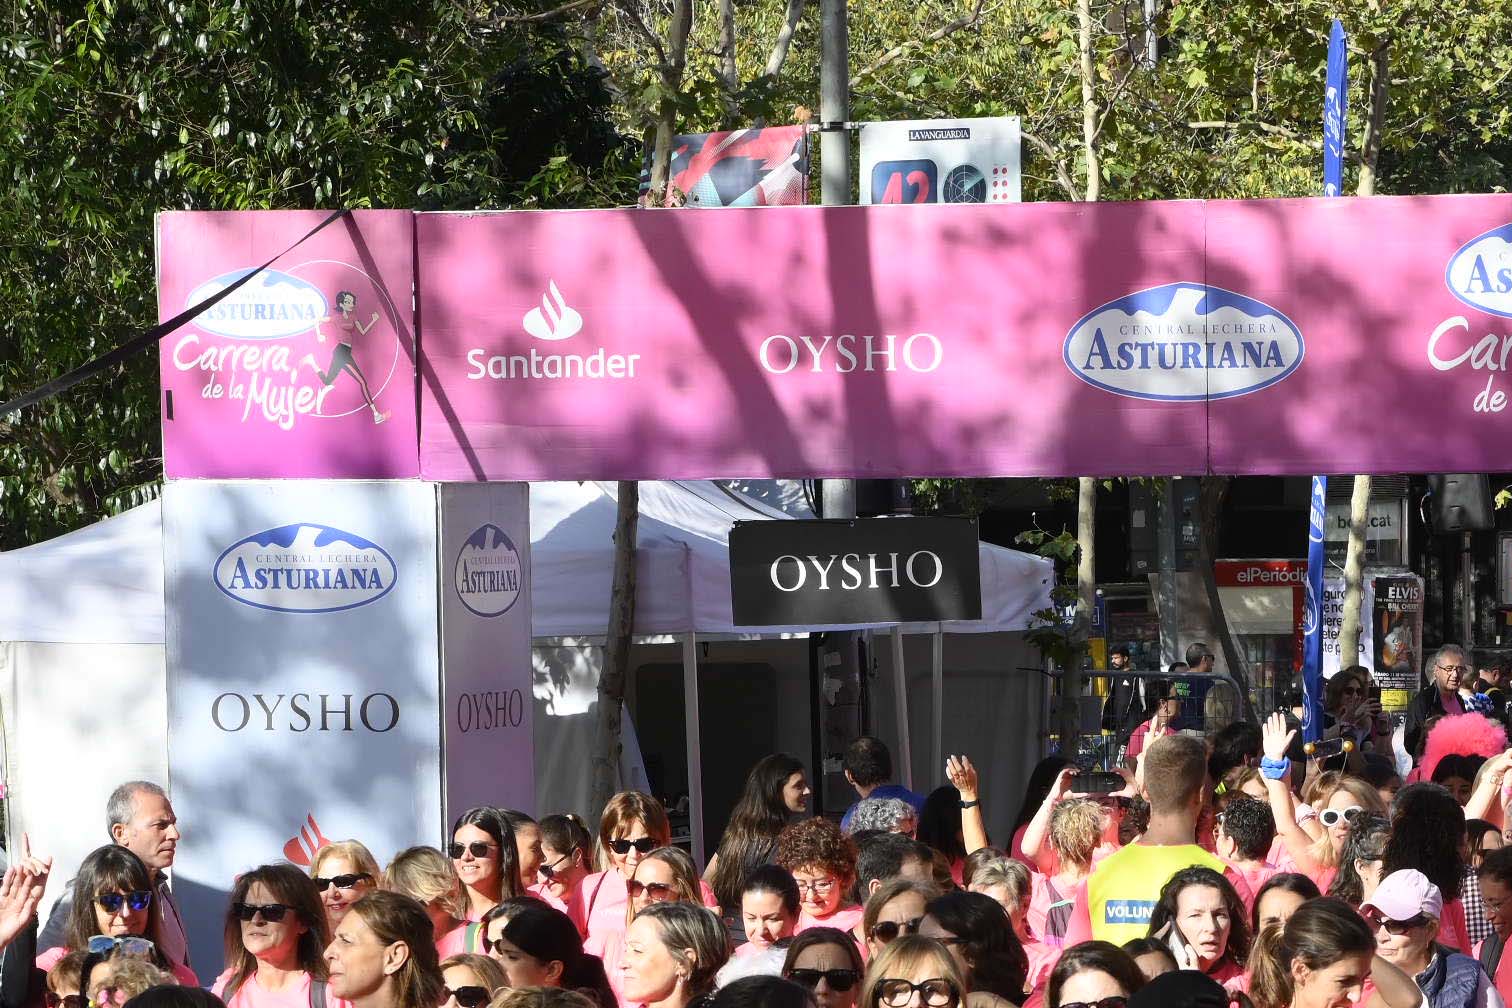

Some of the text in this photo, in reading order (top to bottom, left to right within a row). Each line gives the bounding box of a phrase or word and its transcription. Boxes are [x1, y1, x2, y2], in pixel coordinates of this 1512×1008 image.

[910, 128, 969, 140] LA VANGUARDIA
[1120, 321, 1277, 336] CENTRAL LECHERA
[172, 335, 292, 372] Carrera
[466, 348, 641, 380] Santander
[759, 333, 944, 375] OYSHO
[1083, 327, 1286, 371] ASTURIANA
[202, 369, 336, 431] de la Mujer
[1473, 374, 1508, 413] de
[228, 557, 384, 591] ASTURIANA
[256, 552, 378, 565] CENTRAL LECHERA
[461, 557, 518, 594] ASTURIANA
[770, 550, 943, 592] OYSHO
[1388, 587, 1419, 599] ELVIS
[212, 692, 400, 733] OYSHO
[458, 689, 524, 734] OYSHO
[1106, 906, 1155, 918] VOLUN
